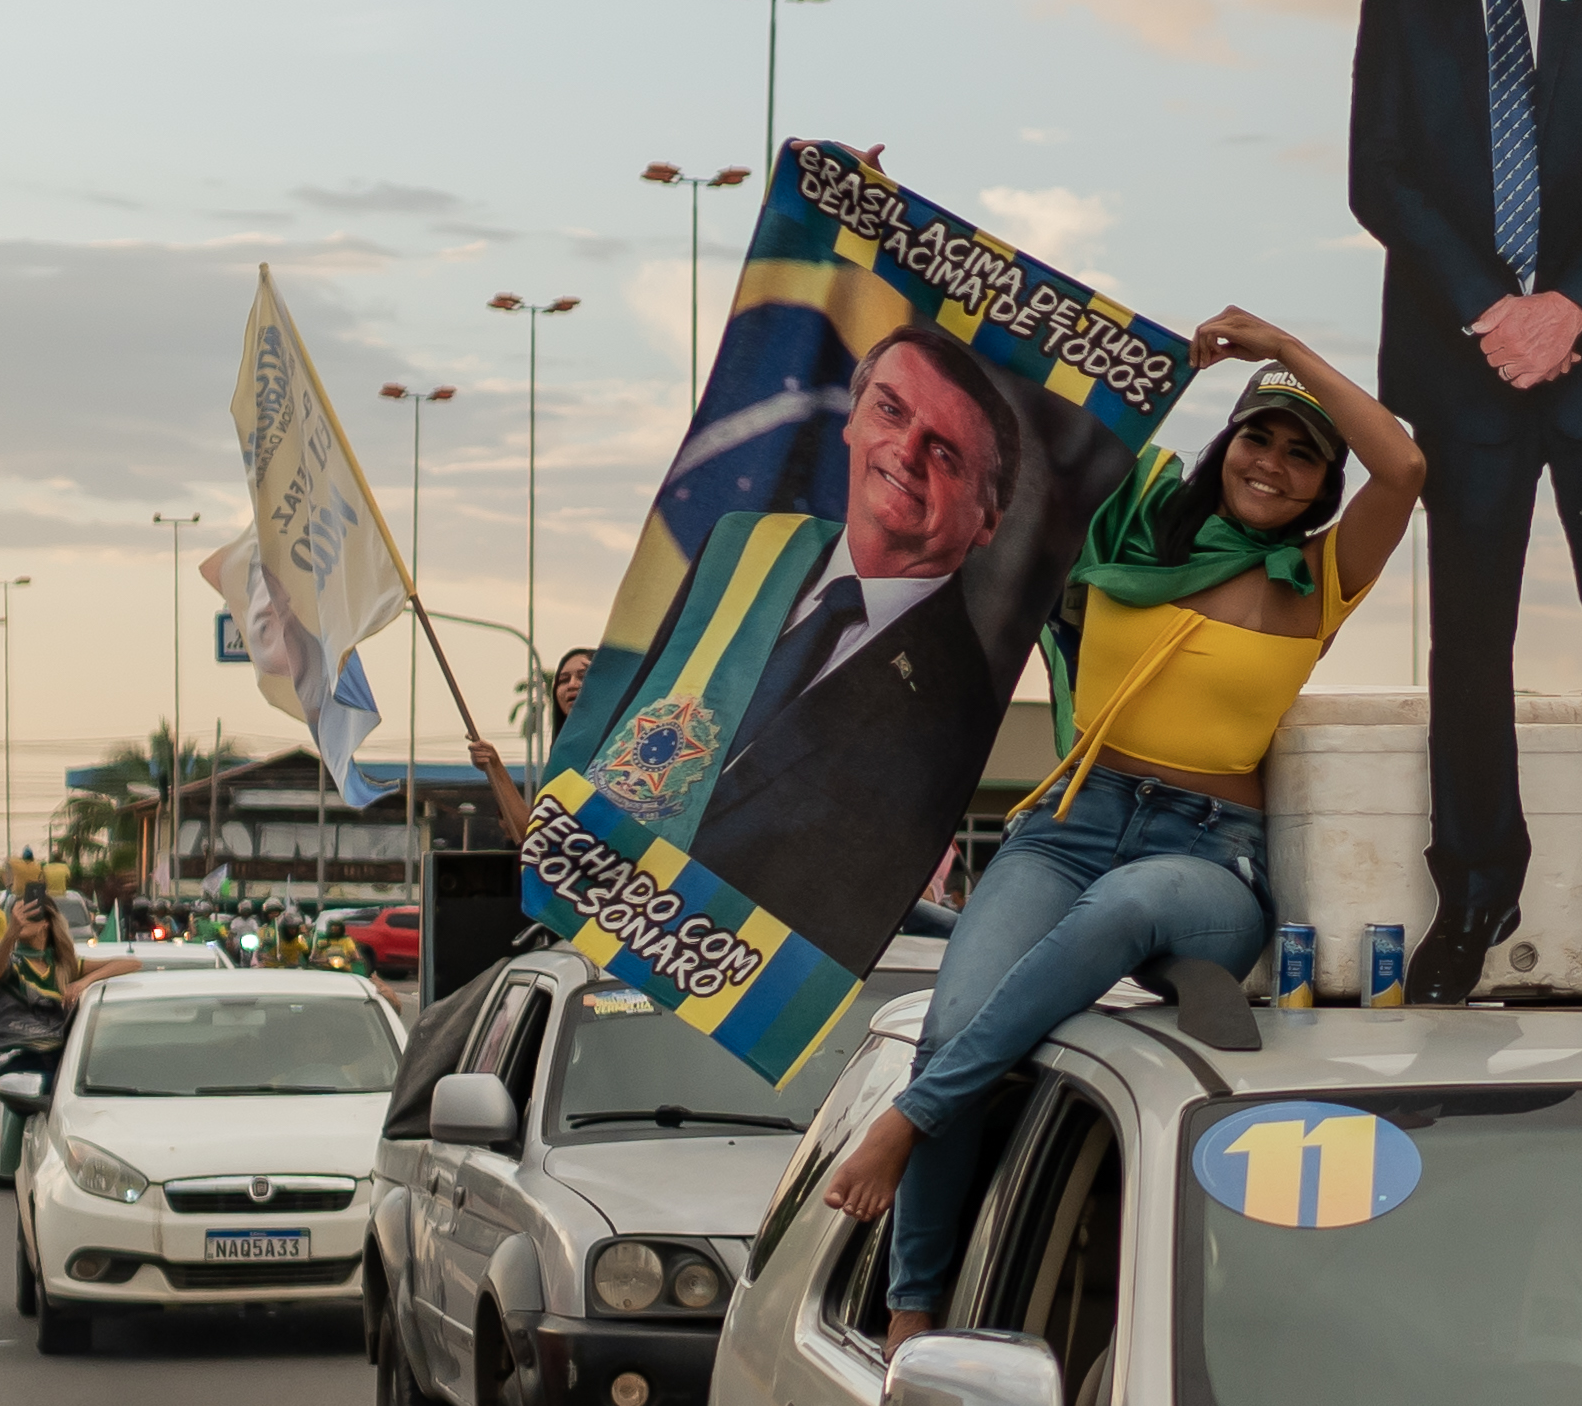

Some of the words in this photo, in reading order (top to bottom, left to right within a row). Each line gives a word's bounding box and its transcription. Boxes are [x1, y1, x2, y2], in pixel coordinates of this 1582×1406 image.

[799, 146, 911, 231] BRASIL
[919, 223, 1023, 296] ACIMA
[1030, 286, 1082, 326] DE
[1089, 314, 1173, 394] TUDO,
[801, 172, 882, 237] DEUS
[884, 231, 986, 311] ACIMA
[989, 296, 1042, 337] DE
[1044, 323, 1154, 412] TODOS.
[520, 831, 723, 995] BOLSONARO
[529, 797, 681, 921] FECHADO
[678, 917, 760, 982] COM
[216, 1239, 299, 1258] NAQ5A33
[1223, 1114, 1377, 1229] 11
